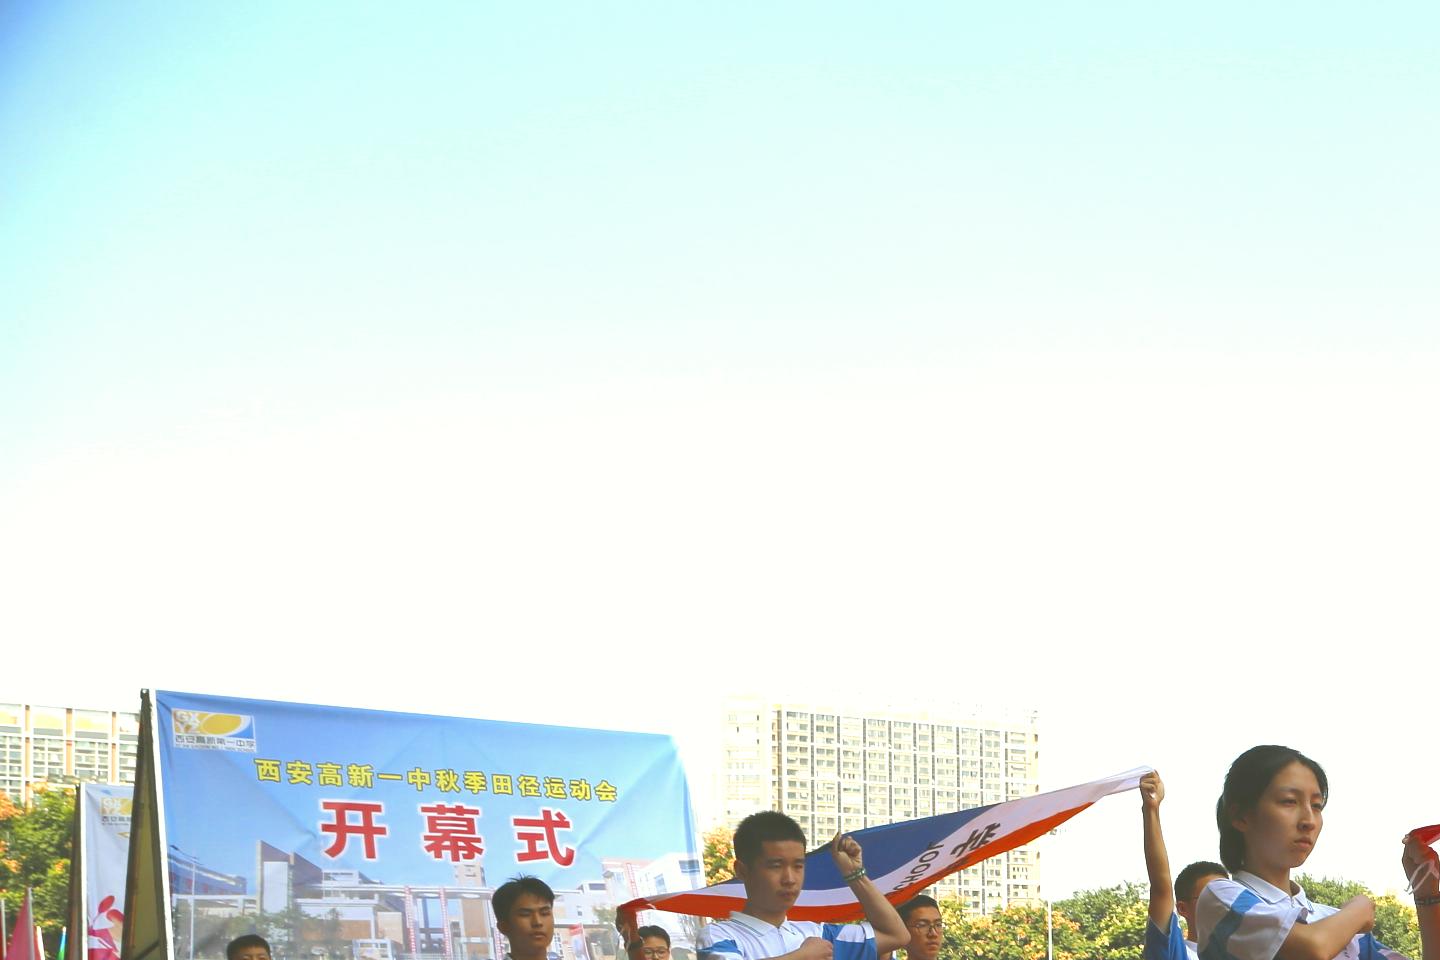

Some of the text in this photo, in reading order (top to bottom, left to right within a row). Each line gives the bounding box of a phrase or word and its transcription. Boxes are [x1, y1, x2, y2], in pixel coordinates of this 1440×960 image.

[254, 758, 618, 802] 西安高新一中秋季田径运动会
[319, 800, 576, 867] 开幕式
